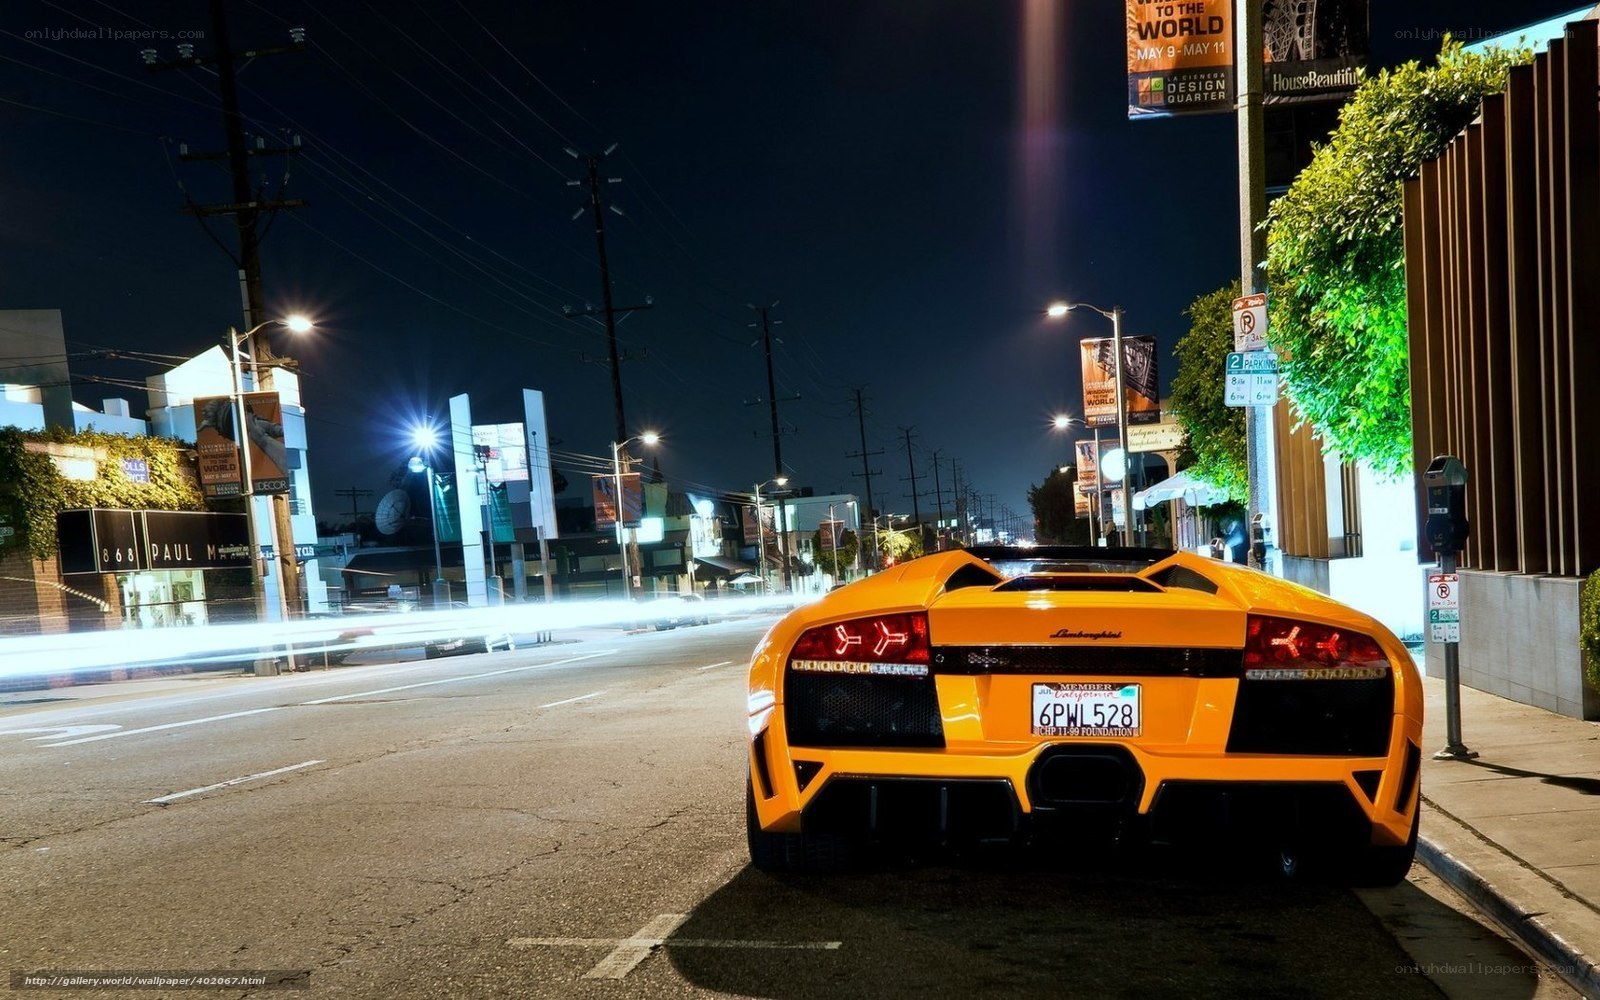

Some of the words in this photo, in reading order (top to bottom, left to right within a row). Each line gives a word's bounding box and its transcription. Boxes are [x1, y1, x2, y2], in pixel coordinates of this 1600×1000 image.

[1156, 6, 1173, 17] TO
[1178, 3, 1204, 14] THE
[1137, 16, 1223, 40] WORLD
[1137, 47, 1163, 60] MAY
[1183, 43, 1209, 56] MAY
[1213, 41, 1225, 53] 11
[1182, 73, 1225, 81] CIENEGA
[1167, 80, 1226, 93] DESIGN
[1167, 91, 1226, 103] QUARTER
[1231, 355, 1240, 368] 2
[1244, 359, 1276, 369] PARKING
[1087, 398, 1115, 406] WORLD
[124, 461, 146, 472] OLLS
[203, 464, 236, 472] WORLD
[257, 480, 287, 491] DECOR
[151, 543, 193, 561] PAUL
[1431, 610, 1438, 620] 2
[1049, 629, 1122, 640] Lamborghini
[1039, 703, 1133, 728] 6PWL528
[1040, 727, 1057, 736] CHP
[1059, 727, 1080, 736] 11-99
[1082, 727, 1134, 736] FOUNDATION
